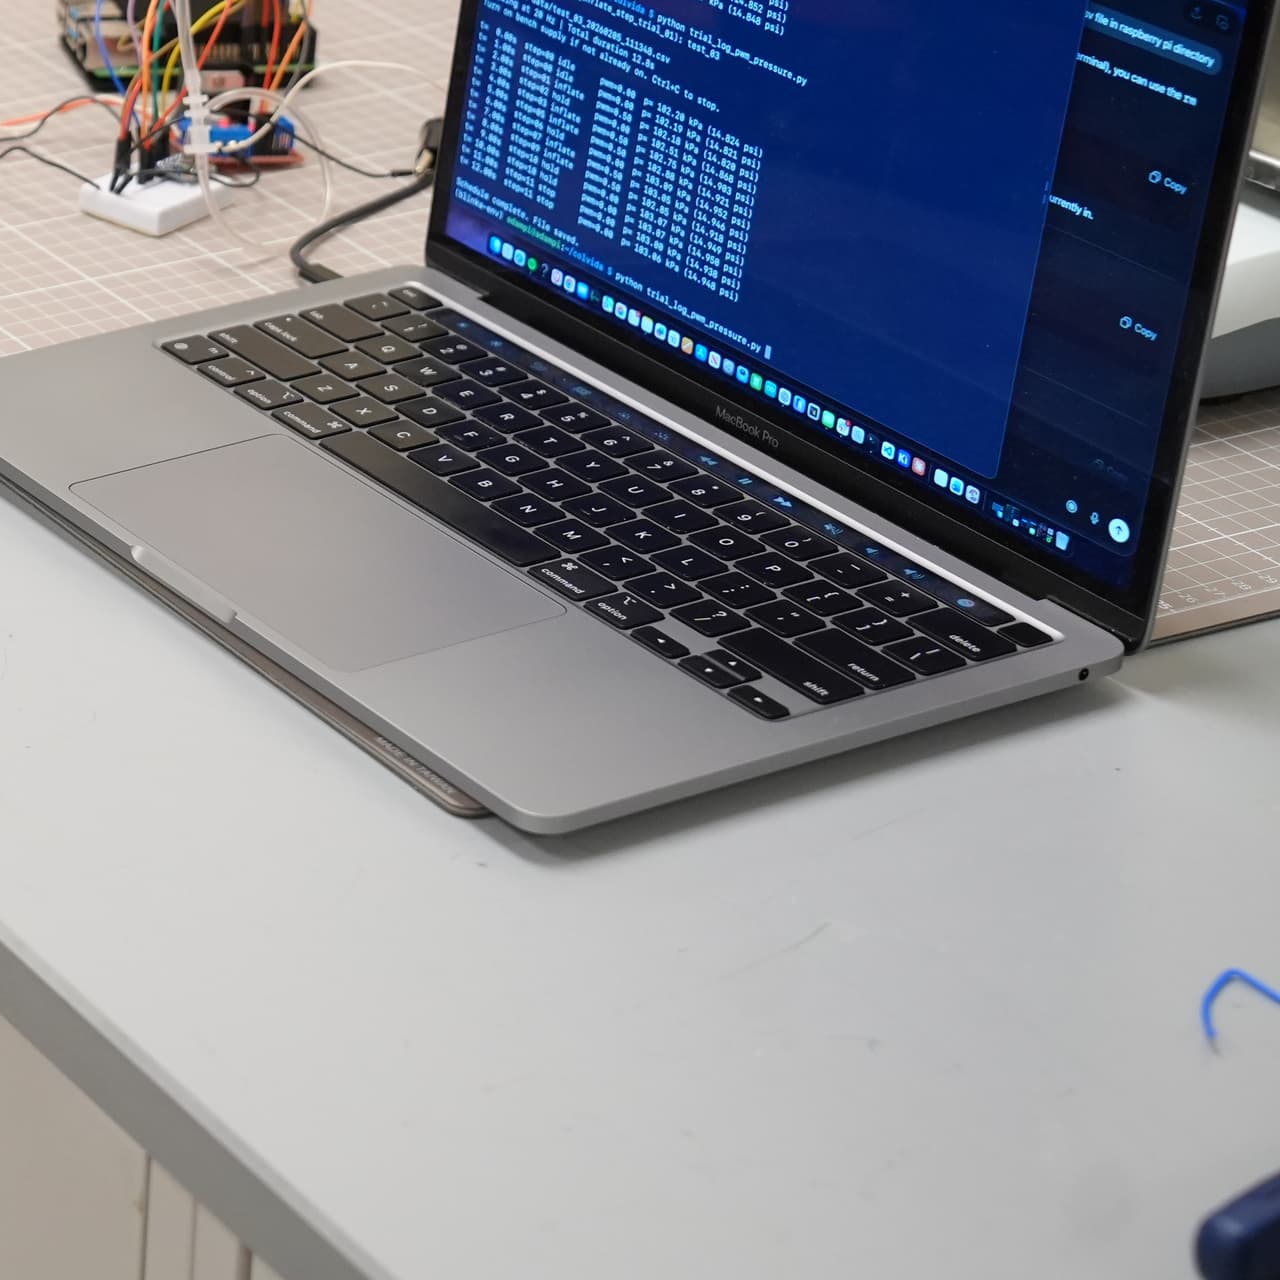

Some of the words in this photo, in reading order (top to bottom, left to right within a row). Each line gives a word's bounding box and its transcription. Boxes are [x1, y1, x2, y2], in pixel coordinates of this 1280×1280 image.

[728, 4, 761, 25] (14.848
[764, 22, 784, 35] psi)
[522, 4, 530, 13] at
[547, 14, 555, 25] Hz
[568, 23, 588, 40] Total
[593, 35, 628, 57] duration
[1094, 12, 1109, 25] file
[1118, 24, 1162, 47] raspberry
[1172, 43, 1214, 67] directory
[657, 14, 685, 32] python
[689, 27, 807, 86] trial_log_pwm_pressure.py
[687, 39, 720, 60] test_03
[504, 8, 512, 17] on
[516, 12, 537, 28] bench
[541, 25, 566, 43] supply
[570, 36, 579, 47] if
[583, 44, 595, 56] not
[600, 52, 631, 72] already
[635, 68, 647, 79] on.
[652, 74, 680, 94] Ctrl+C
[684, 89, 693, 100] to
[697, 96, 719, 112] stop.
[1112, 67, 1130, 79] you
[1130, 74, 1148, 86] can
[1148, 81, 1166, 93] use
[1166, 87, 1182, 100] the
[1164, 178, 1186, 194] Copy
[456, 177, 489, 200] Schedule
[492, 196, 528, 220] complete.
[533, 216, 550, 231] File
[554, 228, 578, 246] saved.
[616, 272, 642, 291] python
[1135, 324, 1157, 340] Copy
[381, 345, 395, 354] Q
[343, 361, 359, 370] A
[207, 364, 236, 381] control
[420, 366, 437, 377] W
[318, 384, 333, 392] Z
[383, 384, 398, 392] S
[247, 387, 272, 404] option
[459, 390, 474, 398] E
[355, 407, 372, 415] X
[422, 407, 437, 416] D
[282, 410, 321, 434] command
[499, 412, 515, 422] R
[716, 406, 760, 438] MacBook
[762, 431, 779, 448] Pro
[396, 431, 411, 439] C
[463, 431, 479, 439] F
[543, 437, 558, 446] T
[437, 455, 453, 464] V
[504, 455, 520, 464] G
[585, 461, 600, 469] Y
[477, 480, 493, 488] B
[546, 479, 563, 488] H
[627, 486, 644, 495] U
[519, 504, 537, 514] N
[562, 531, 582, 540] M
[635, 531, 652, 540] K
[718, 538, 734, 546] O
[681, 558, 694, 566] L
[541, 567, 585, 595] command
[597, 601, 627, 621] option
[948, 633, 981, 653] delete
[847, 662, 880, 682] return
[803, 681, 829, 696] shift
